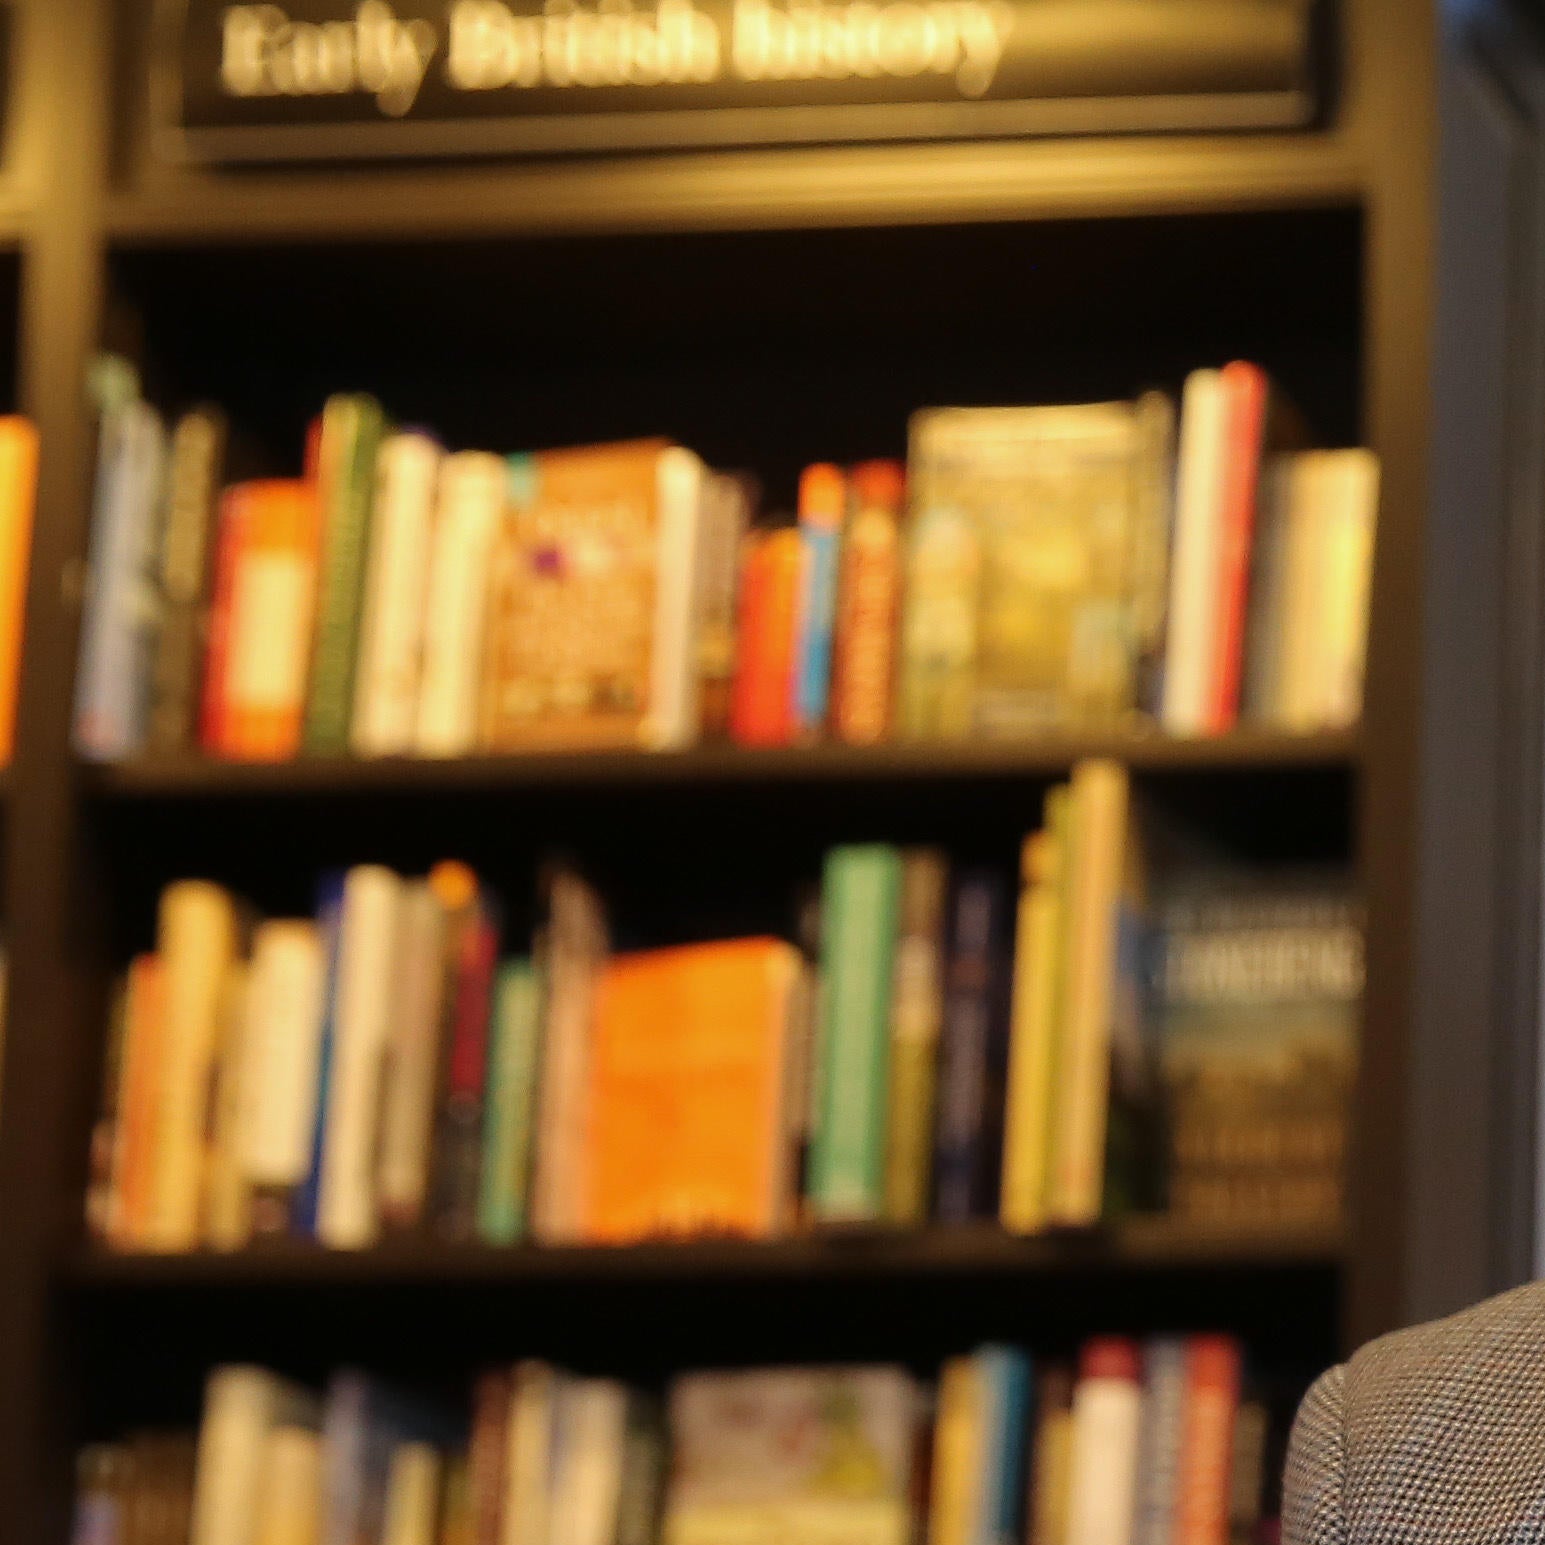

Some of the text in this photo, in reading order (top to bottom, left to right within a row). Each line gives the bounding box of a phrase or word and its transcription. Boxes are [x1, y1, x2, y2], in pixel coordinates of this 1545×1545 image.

[222, 0, 1008, 117] Early British history
